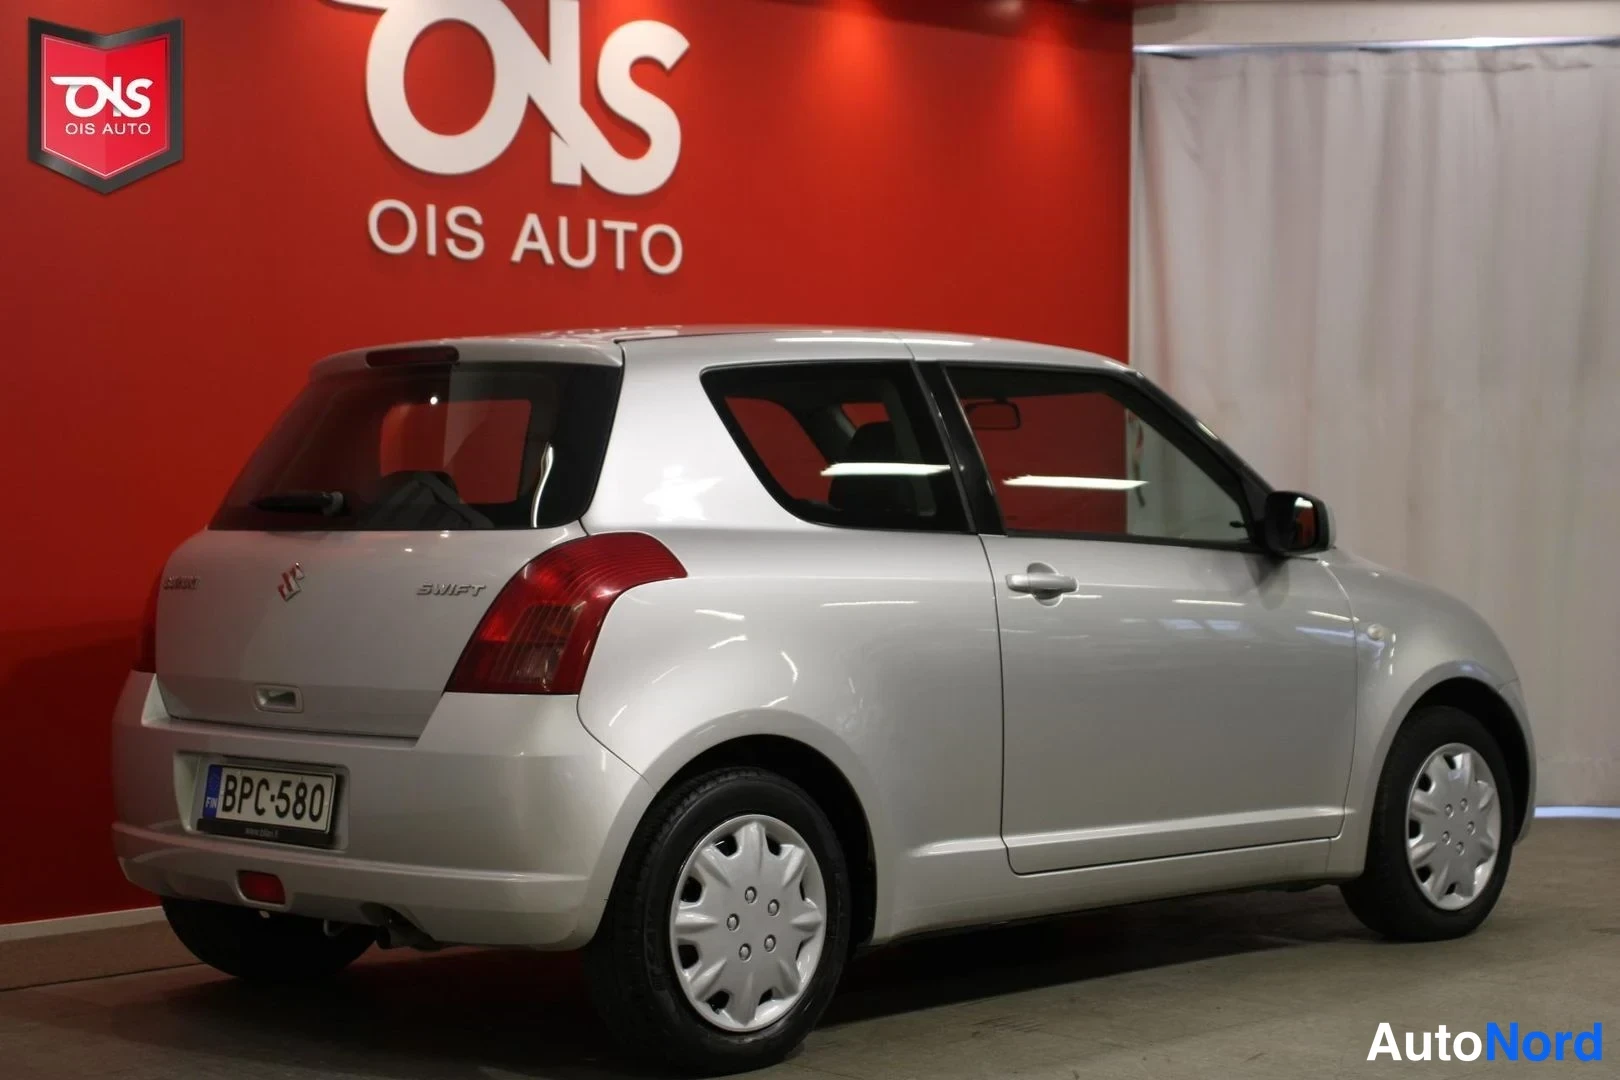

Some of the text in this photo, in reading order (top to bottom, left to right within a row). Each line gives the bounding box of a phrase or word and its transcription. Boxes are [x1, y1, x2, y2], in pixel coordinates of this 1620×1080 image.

[322, 0, 690, 196] OIS
[368, 199, 684, 275] OIS AUTO
[416, 582, 487, 597] SWIFT
[205, 796, 218, 809] FIN
